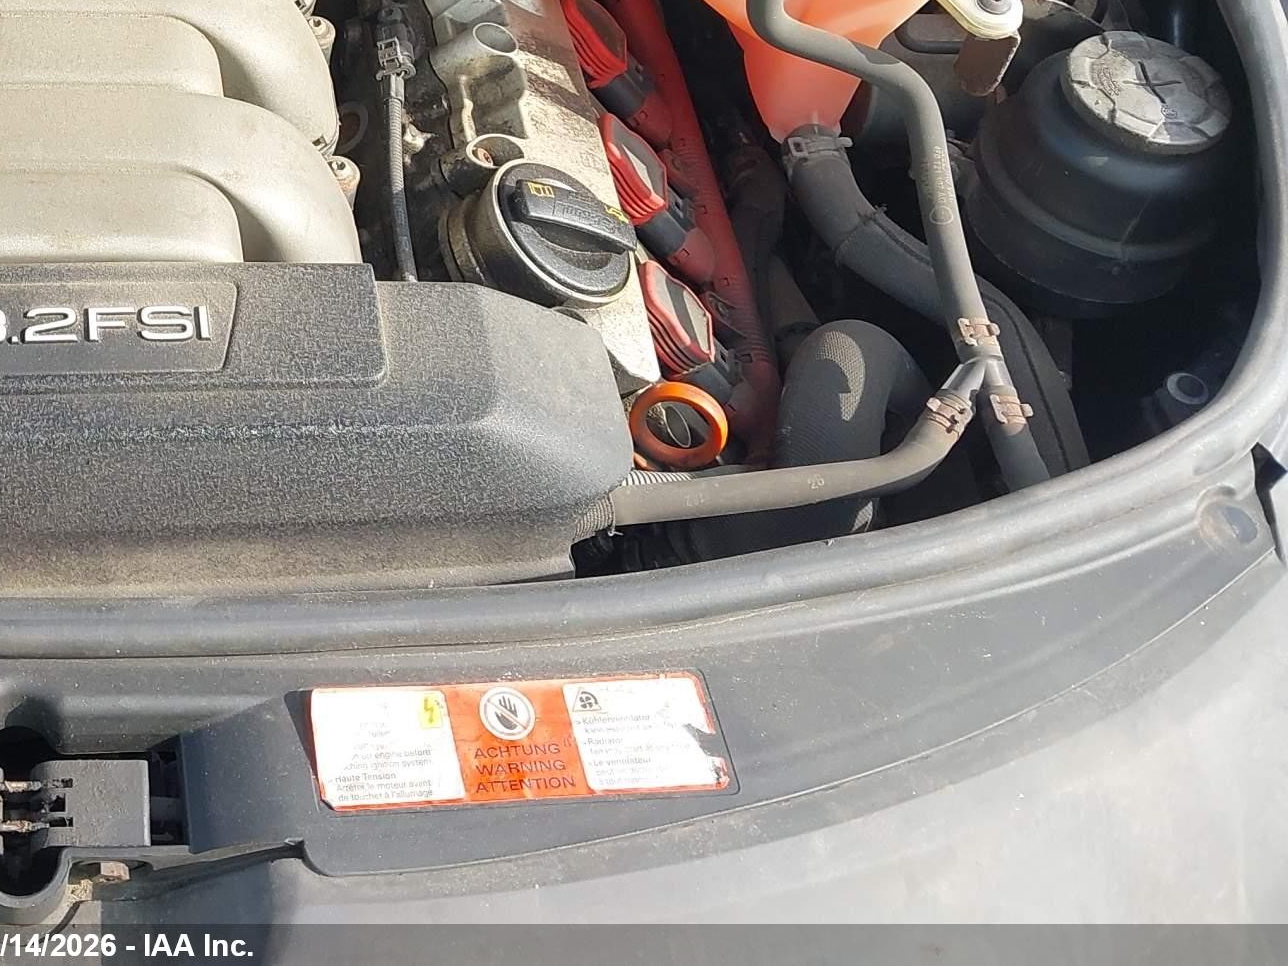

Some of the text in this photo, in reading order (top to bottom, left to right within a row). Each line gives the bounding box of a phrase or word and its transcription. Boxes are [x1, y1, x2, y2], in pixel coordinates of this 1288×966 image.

[475, 743, 560, 759] ACHTUNG
[476, 759, 566, 776] WARNING
[361, 772, 396, 782] Tension
[476, 776, 576, 793] ATTENTION
